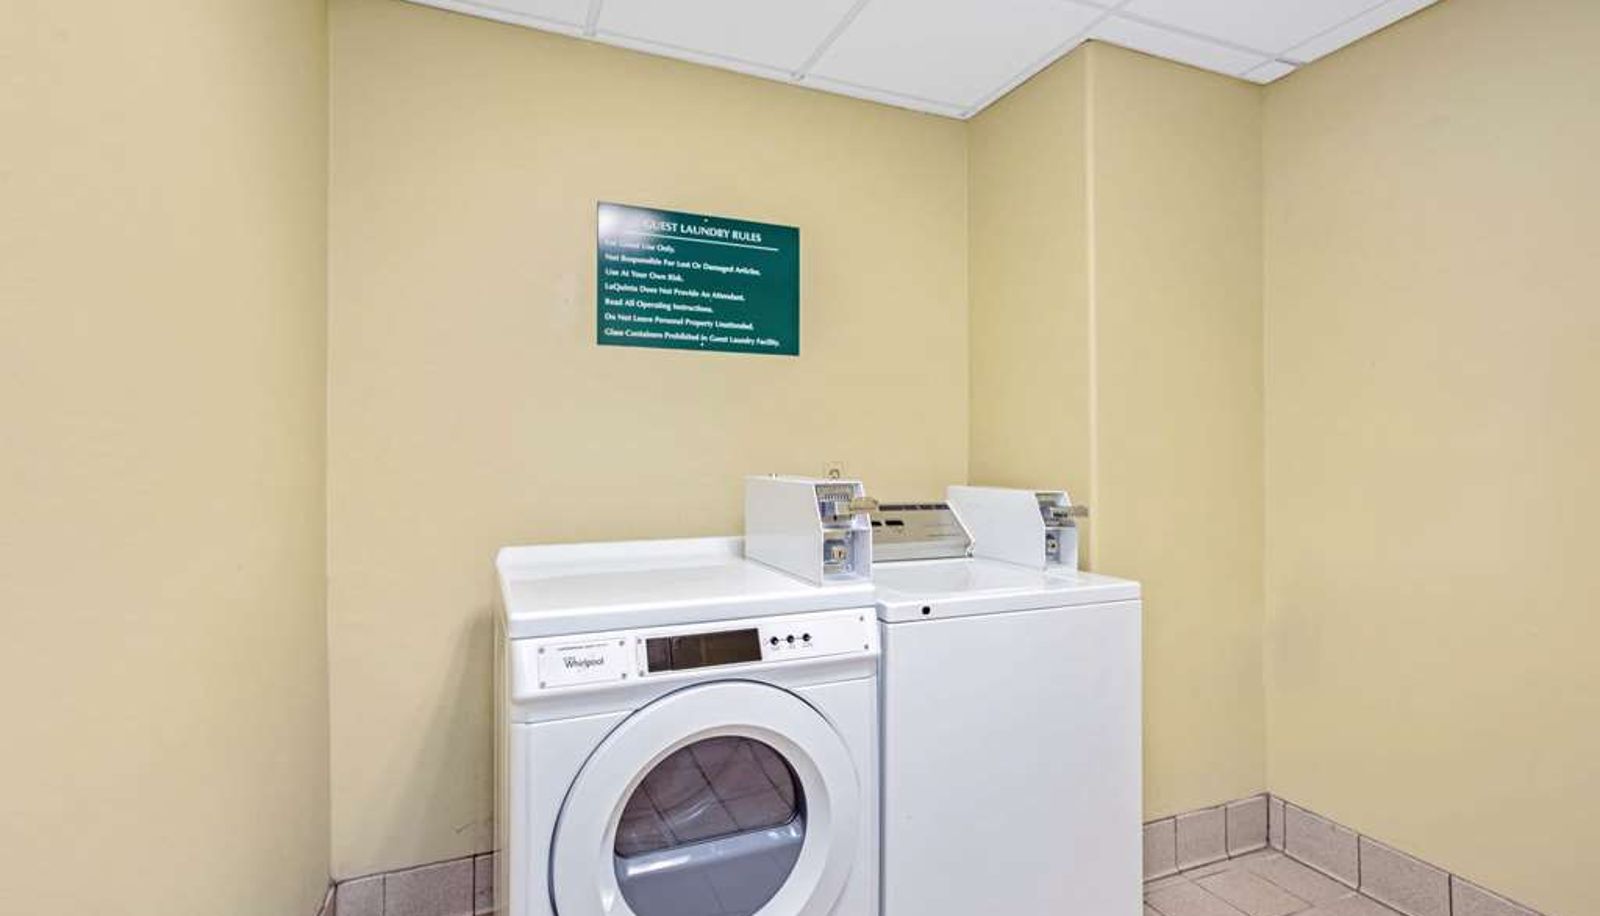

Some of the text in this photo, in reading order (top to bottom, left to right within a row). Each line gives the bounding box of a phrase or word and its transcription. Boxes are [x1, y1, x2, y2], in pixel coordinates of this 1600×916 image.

[681, 224, 730, 239] LAUNDRY
[732, 230, 762, 242] RULES
[663, 258, 676, 266] For
[692, 261, 702, 270] Or
[703, 262, 734, 274] Damaged
[604, 267, 619, 276] Use
[620, 268, 630, 277] At
[630, 269, 648, 279] Your
[648, 271, 667, 280] Own
[639, 285, 657, 294] Does
[659, 286, 673, 295] Not
[674, 287, 699, 297] Provide
[700, 290, 711, 298] An
[604, 297, 623, 306] Read
[624, 298, 635, 307] All
[635, 299, 672, 312] Operating
[604, 312, 616, 321] Do
[617, 313, 632, 322] Not
[632, 315, 653, 323] Leave
[654, 315, 683, 325] Personal
[685, 318, 713, 329] Property
[709, 334, 728, 342] Guest
[729, 335, 755, 346] Laundry
[562, 655, 605, 669] Whirlpool
